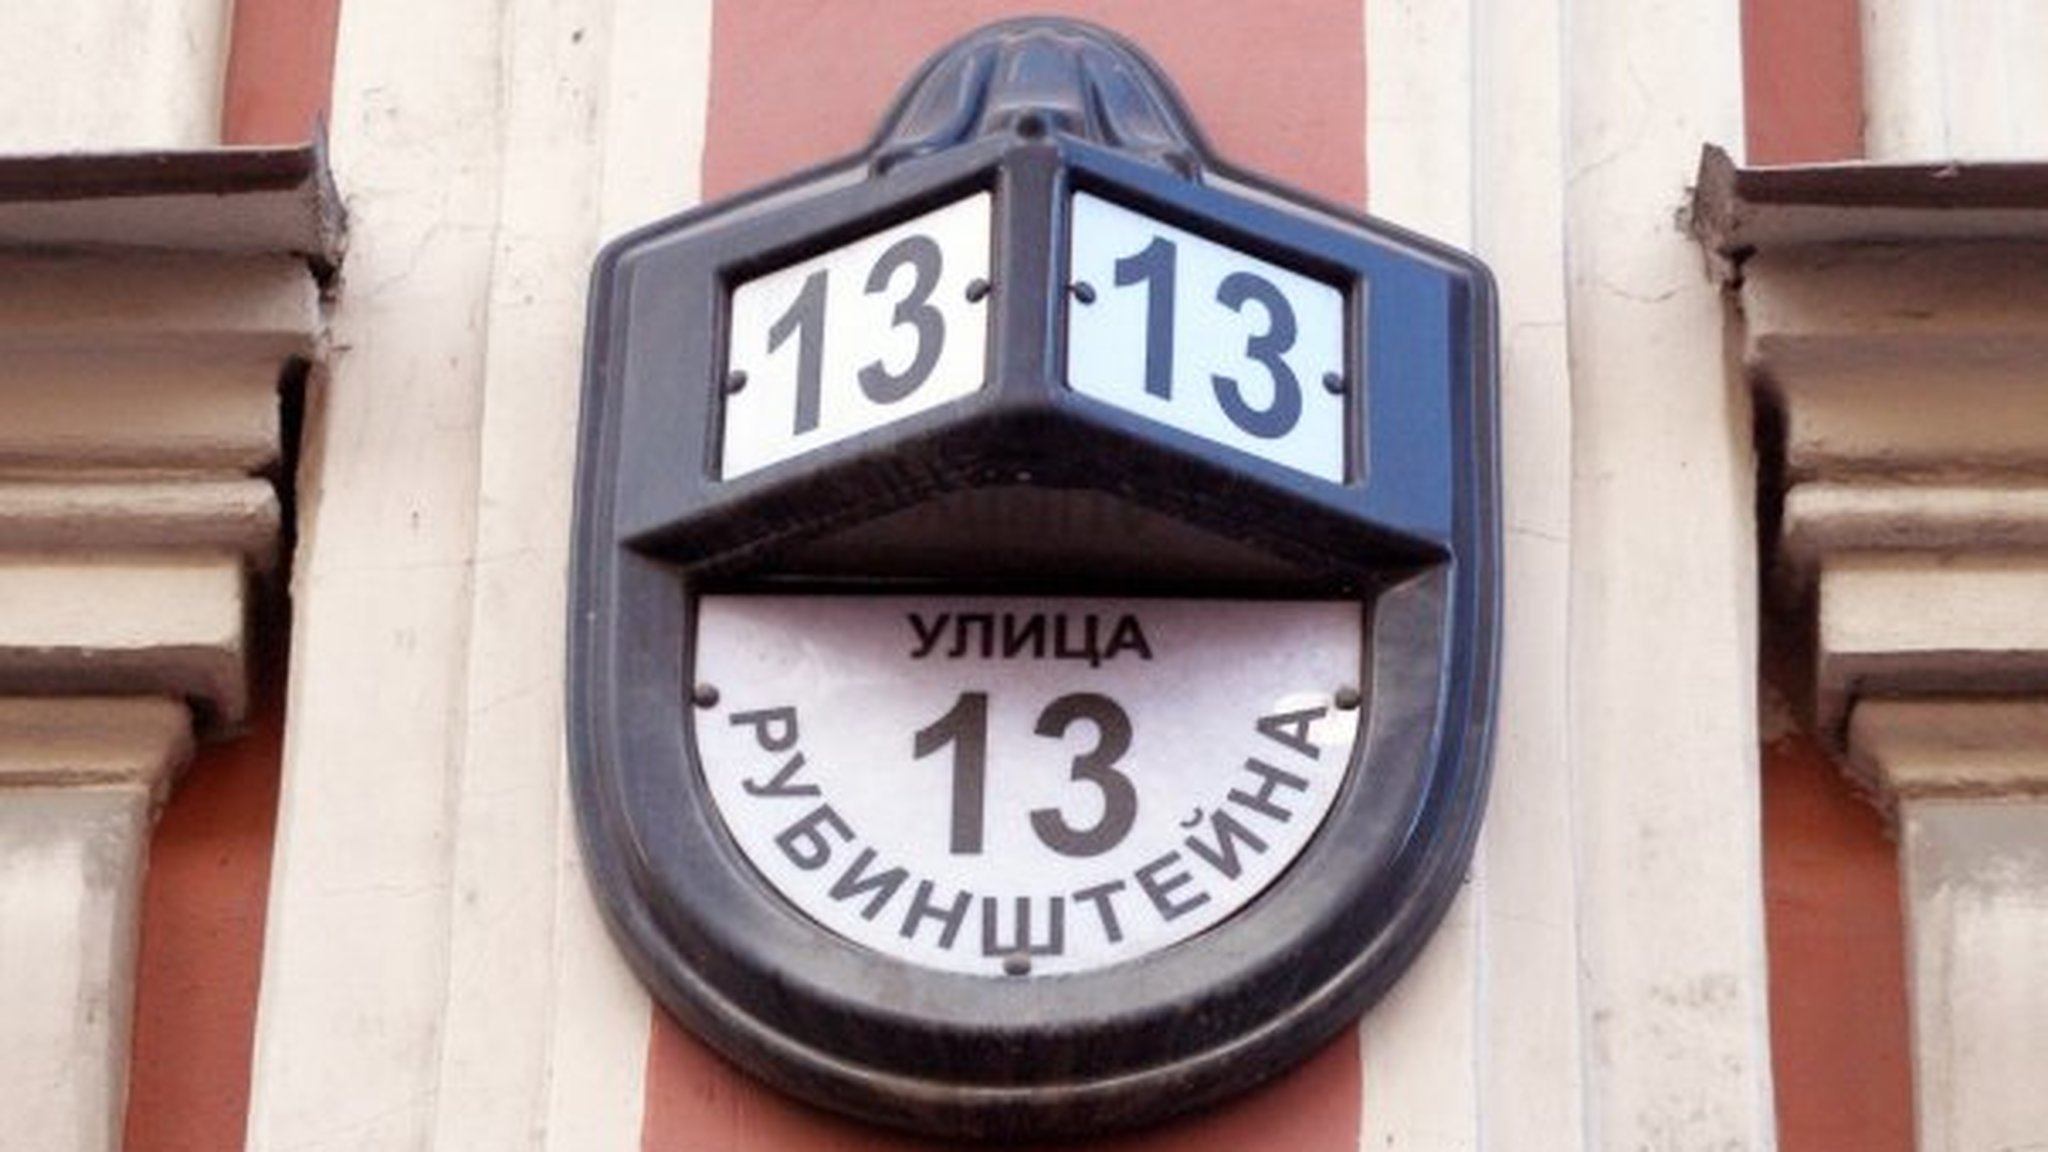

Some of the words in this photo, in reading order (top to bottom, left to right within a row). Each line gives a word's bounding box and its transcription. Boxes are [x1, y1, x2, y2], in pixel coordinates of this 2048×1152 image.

[766, 233, 946, 437] 13
[1114, 235, 1303, 440] 13
[907, 613, 1153, 668] УЛИЦА
[729, 705, 1329, 957] РУБИНШТЕЙНА
[912, 691, 1138, 858] 13
